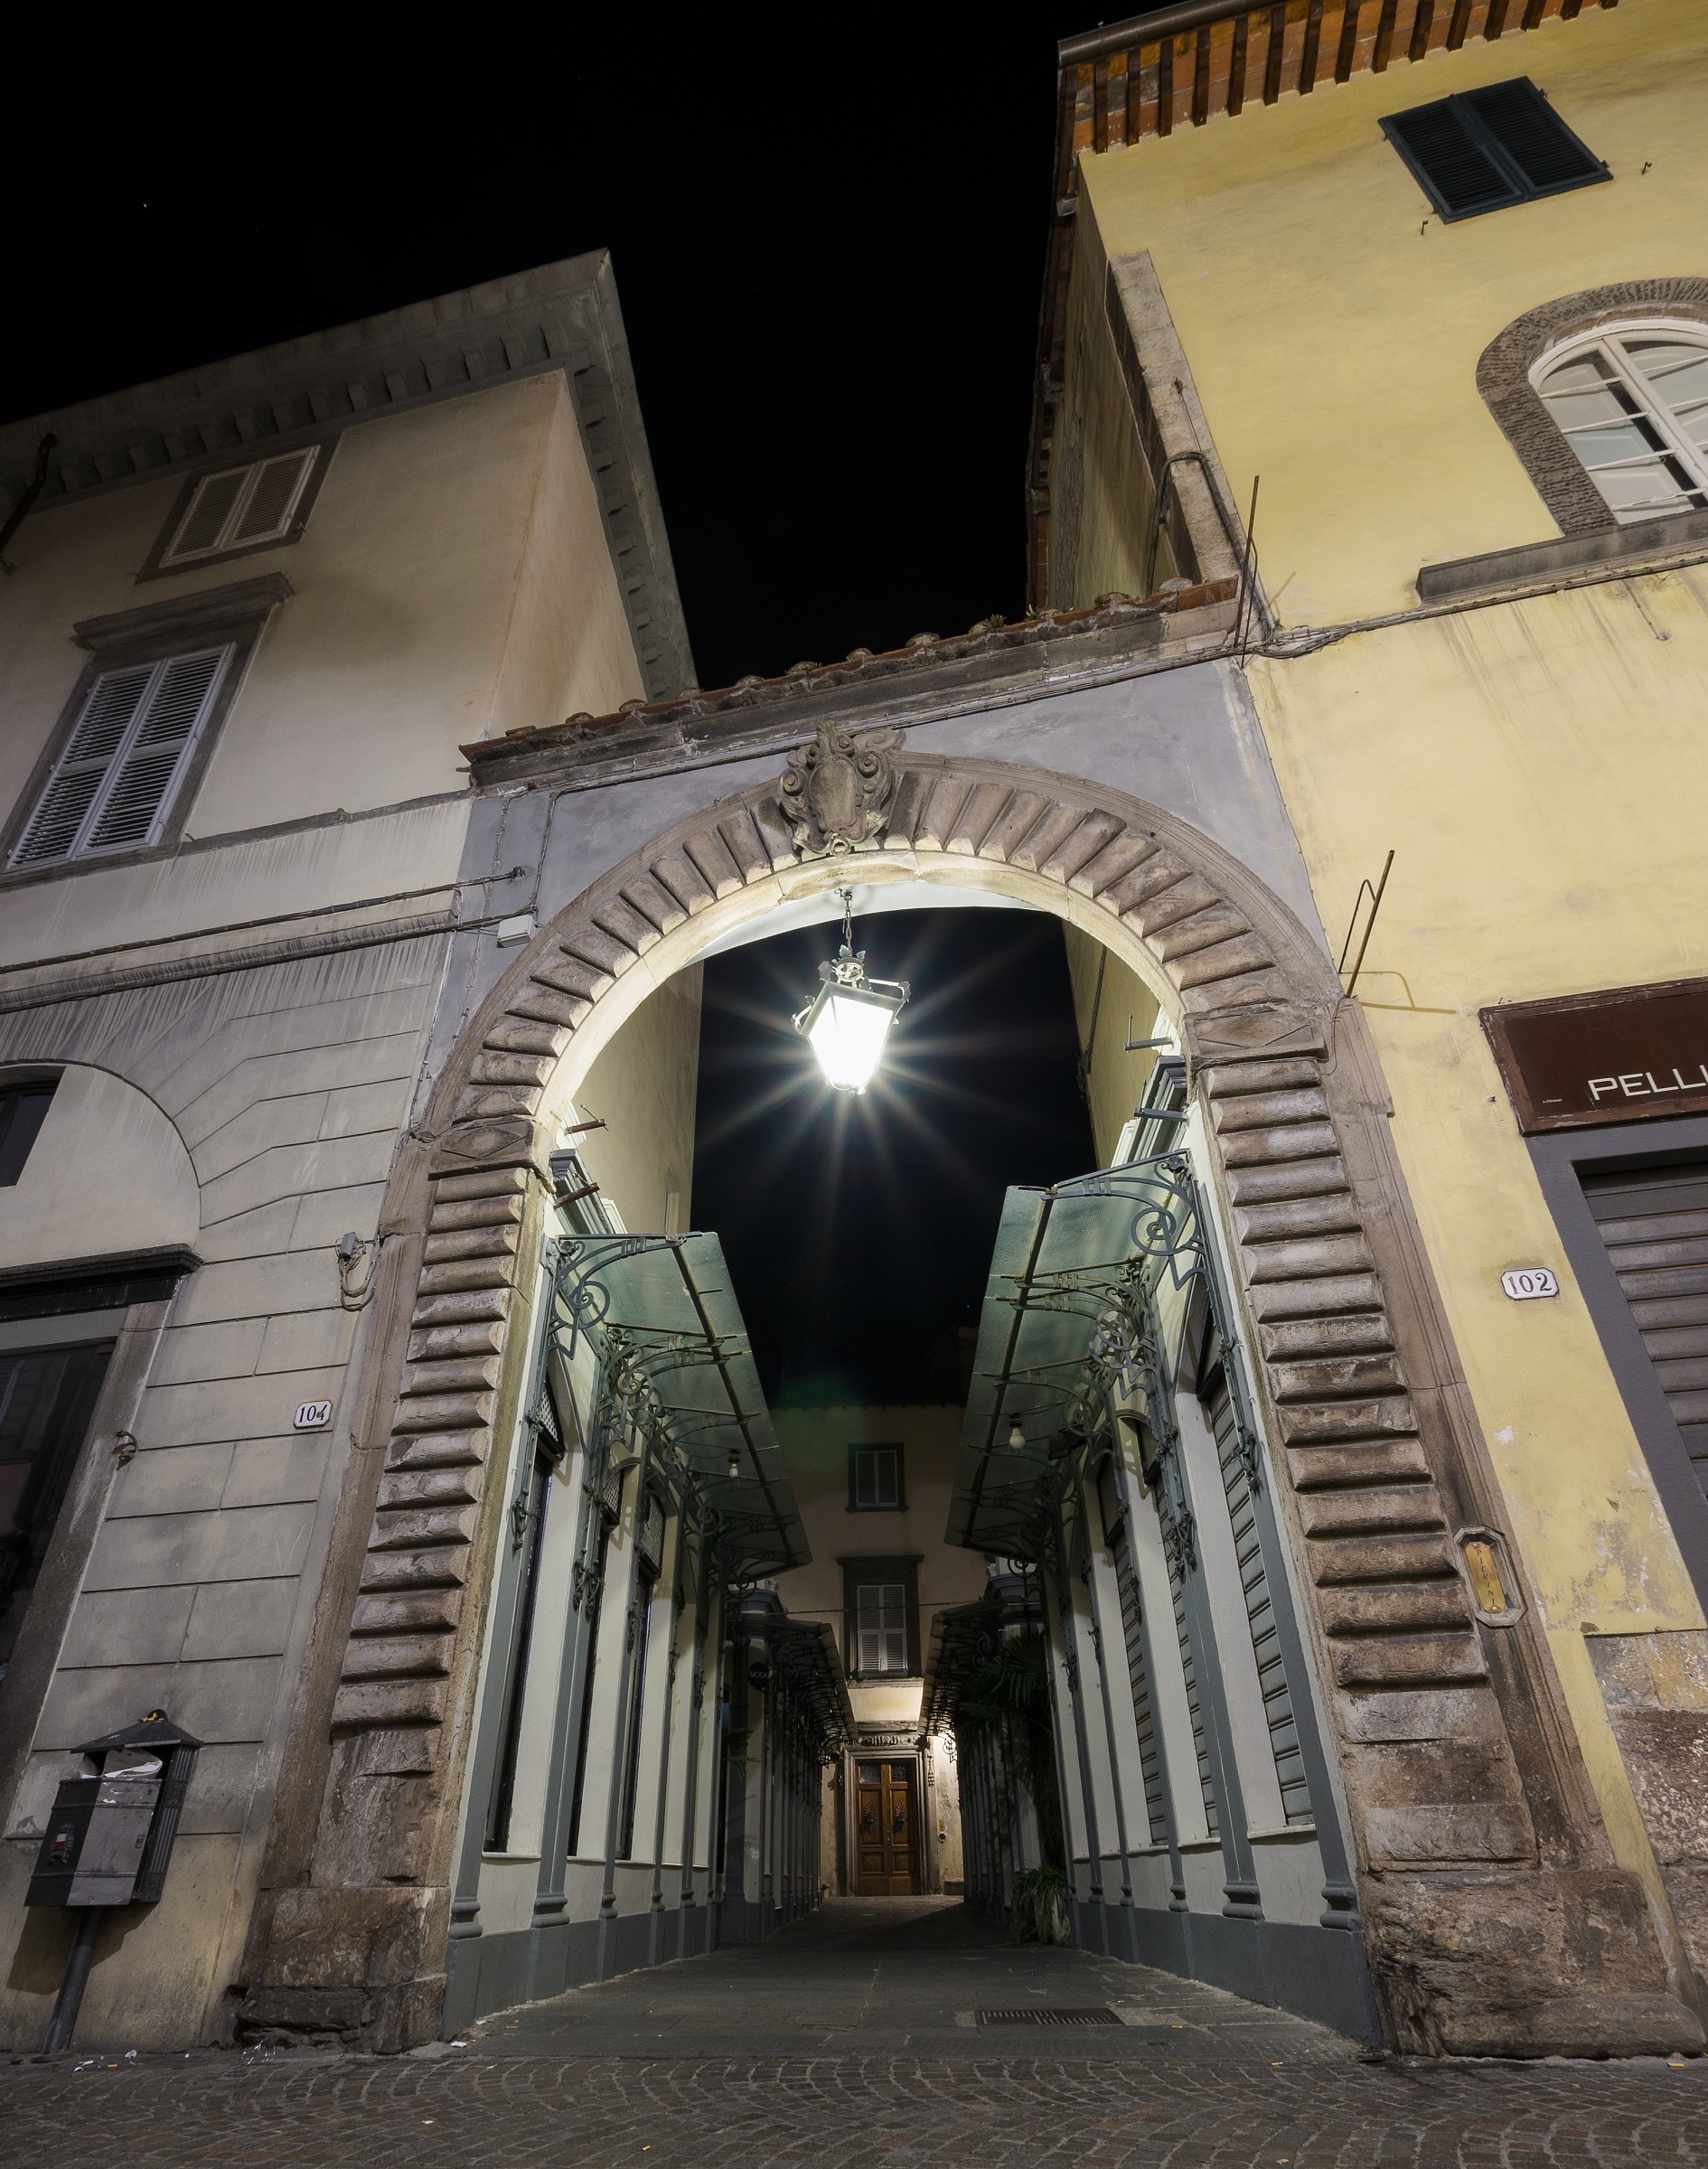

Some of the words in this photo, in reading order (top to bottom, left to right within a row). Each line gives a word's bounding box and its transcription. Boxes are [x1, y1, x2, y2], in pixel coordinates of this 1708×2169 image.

[1507, 1272, 1552, 1294] 102
[298, 1404, 327, 1423] 104
[1477, 1549, 1495, 1605] PIERINI
